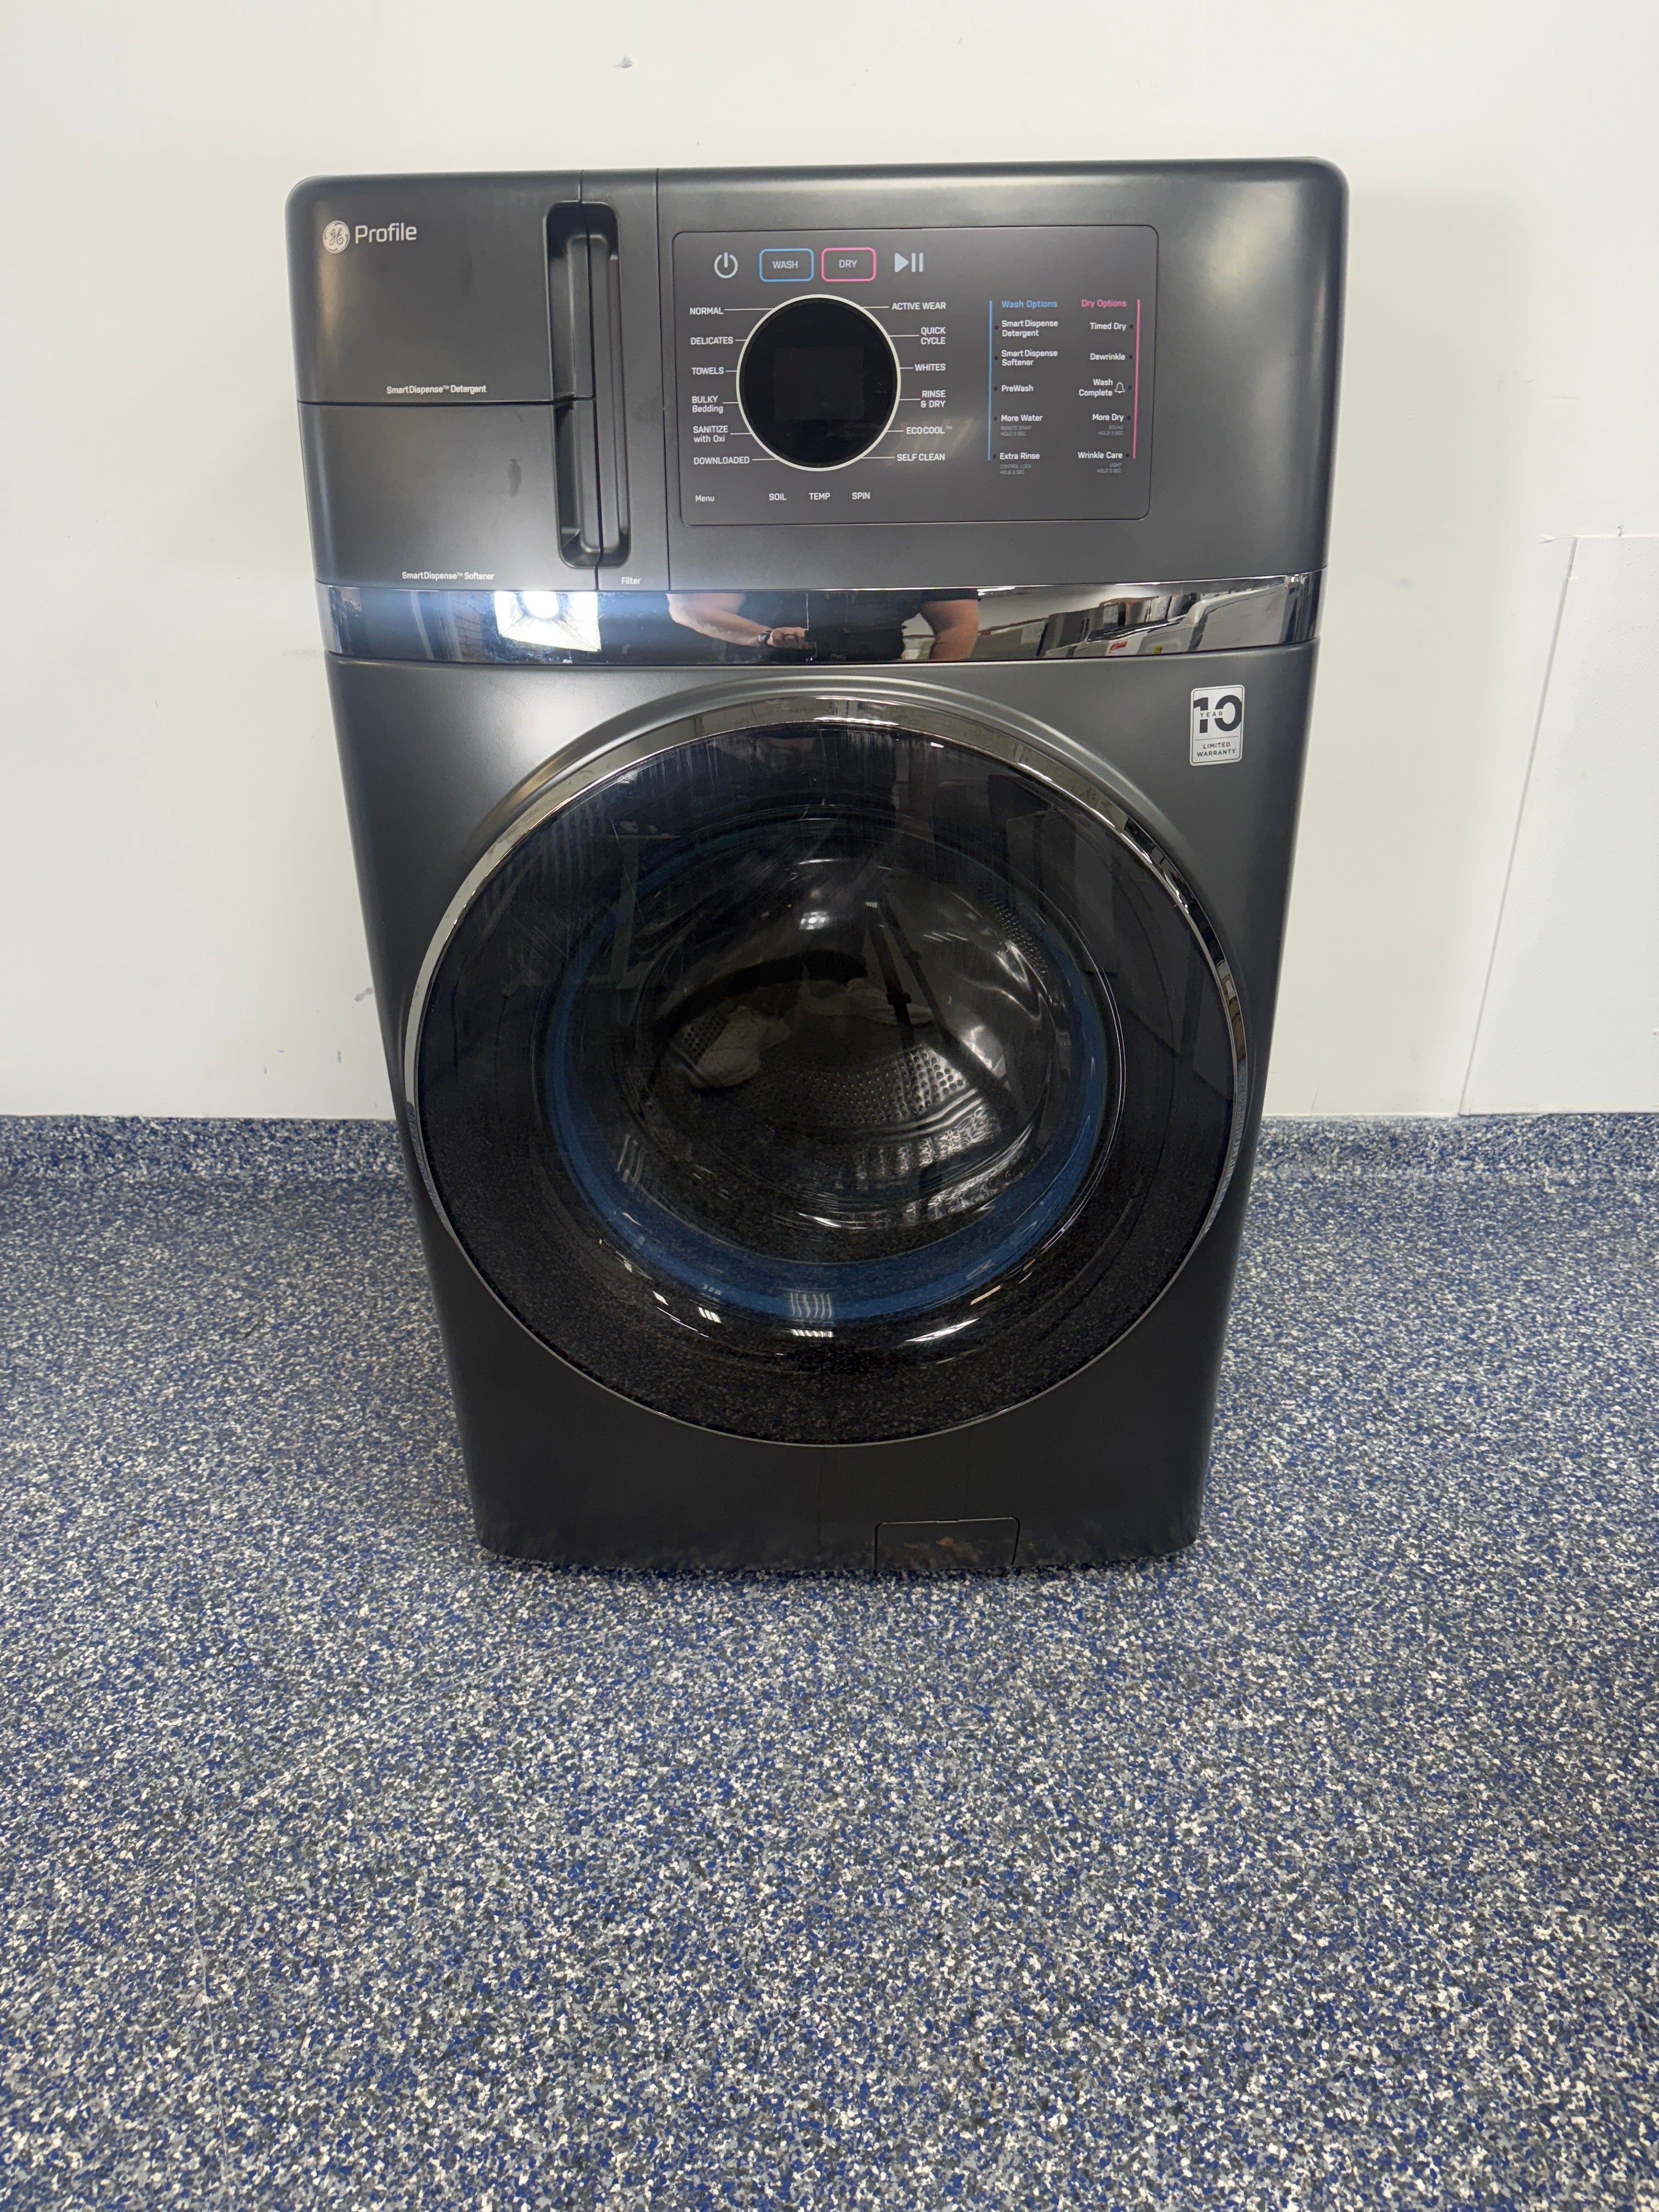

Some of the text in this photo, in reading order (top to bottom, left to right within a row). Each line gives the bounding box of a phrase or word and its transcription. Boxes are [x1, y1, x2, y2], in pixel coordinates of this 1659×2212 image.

[356, 223, 416, 244] Profile
[1027, 300, 1057, 309] Options
[1081, 300, 1126, 308] Dry Options
[921, 327, 945, 336] QUICK
[1114, 323, 1126, 331] Dry
[1002, 330, 1039, 338] Detergent
[450, 385, 487, 394] Detergent
[1079, 389, 1113, 397] Complete
[692, 405, 723, 414] Bedding
[1112, 414, 1124, 422] Dry
[694, 456, 749, 465] DOWNLOADED
[1194, 695, 1242, 733] 10
[1197, 748, 1236, 757] WARRANTY
